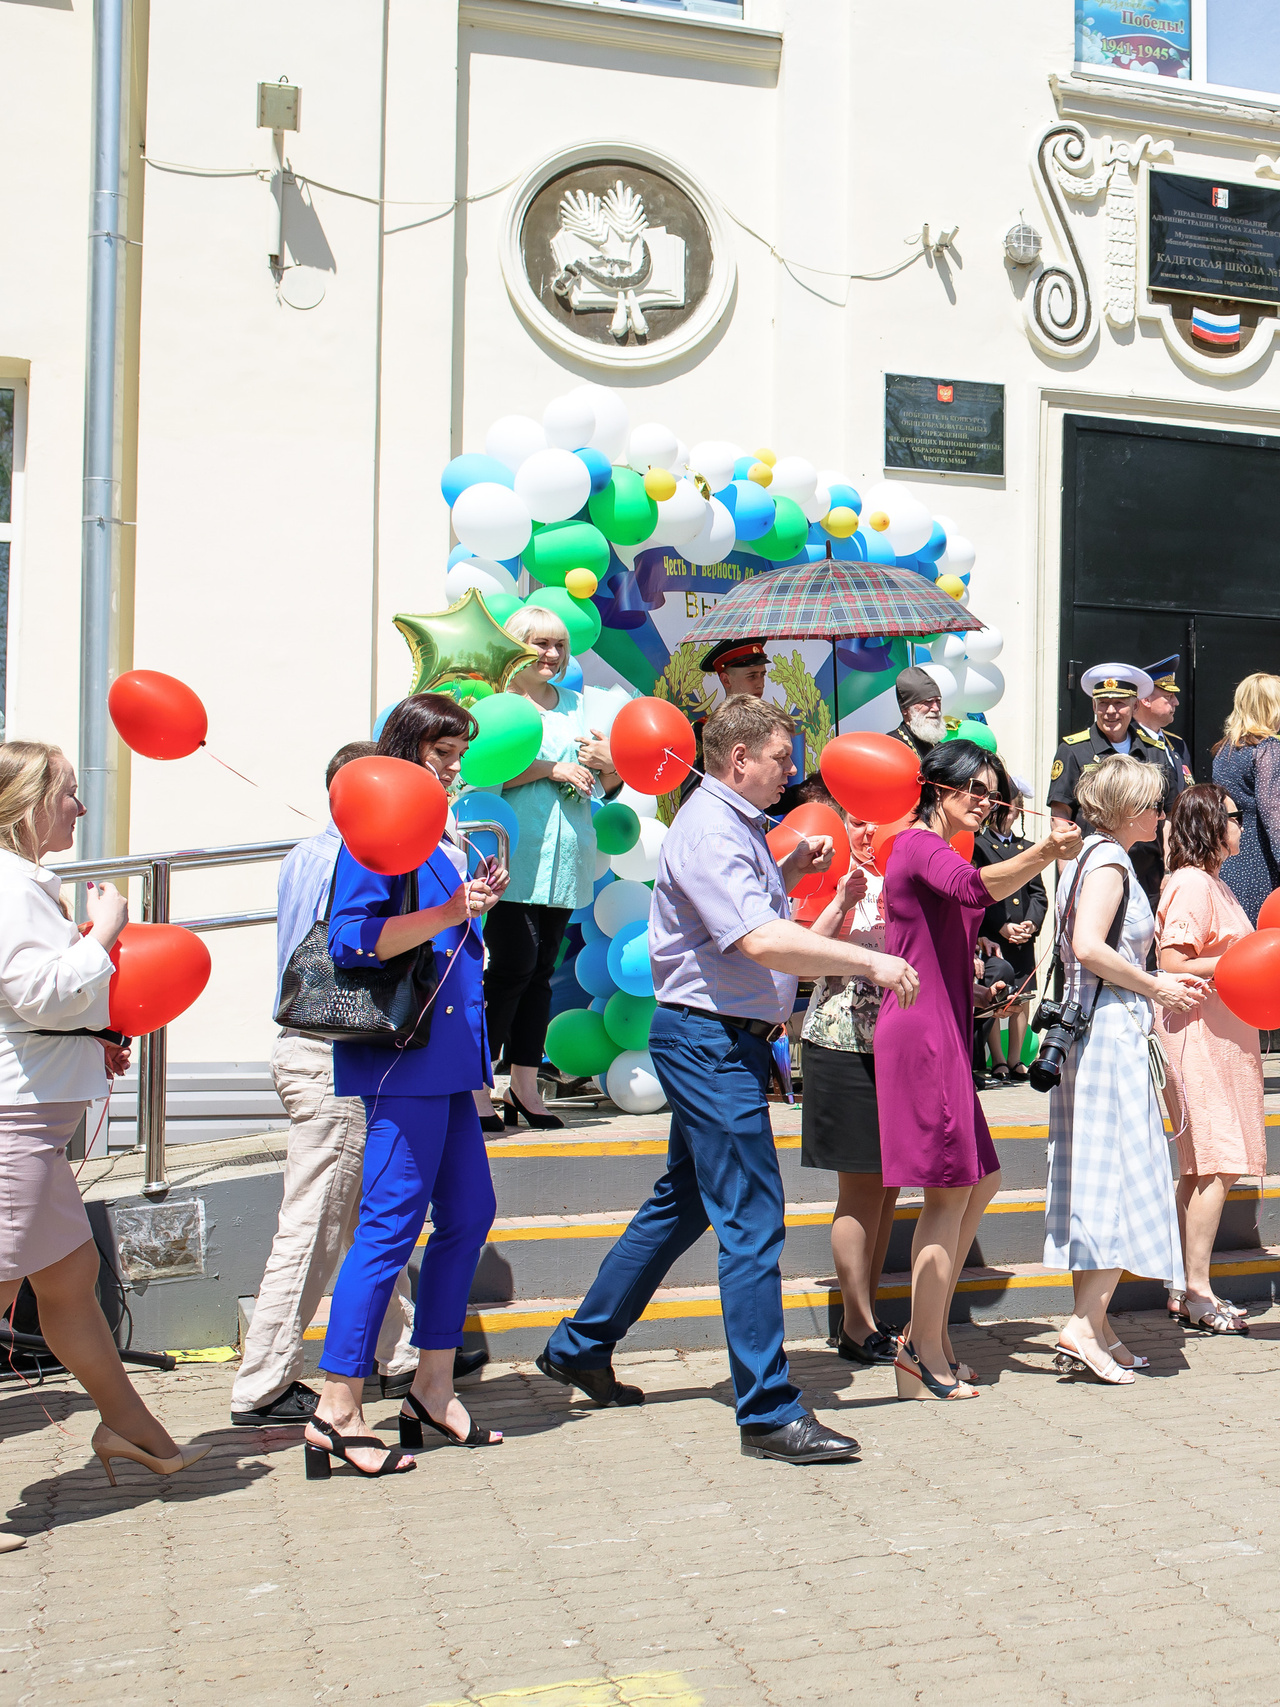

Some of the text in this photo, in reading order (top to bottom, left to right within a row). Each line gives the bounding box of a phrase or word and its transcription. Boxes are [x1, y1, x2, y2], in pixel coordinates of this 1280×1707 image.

[1121, 10, 1184, 34] Победы!
[1101, 38, 1169, 60] 1941-1945
[1151, 214, 1215, 229] АДМИНИСТРАЦИИ
[1215, 223, 1242, 233] ГОРОДА
[1173, 209, 1268, 229] УПРАВЛЕНИЕ ОБРАЗОВАНИЯ
[1156, 252, 1222, 270] КАДЕТСКАЯ
[1225, 262, 1265, 276] ШКОЛА
[1160, 272, 1180, 280] имени
[1181, 273, 1196, 281] Ф.Ф.
[1196, 275, 1223, 285] Ушакова
[1244, 281, 1279, 292] Хабаровска
[663, 555, 687, 576] Честь
[702, 562, 741, 581] верность
